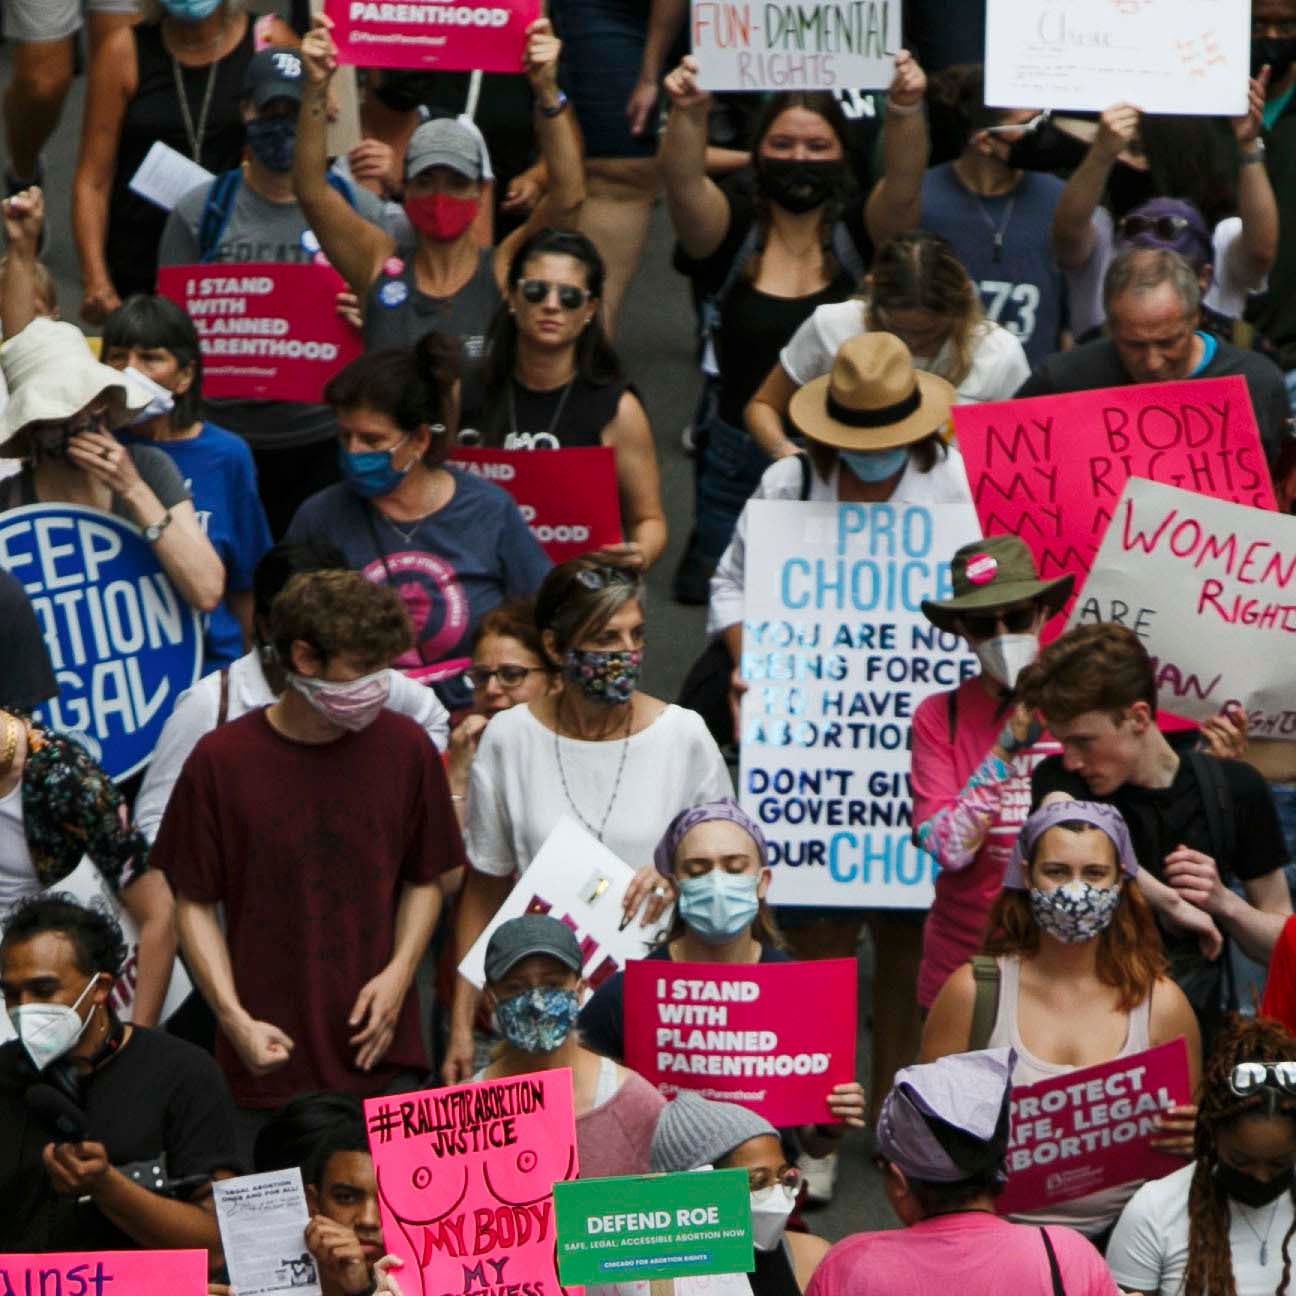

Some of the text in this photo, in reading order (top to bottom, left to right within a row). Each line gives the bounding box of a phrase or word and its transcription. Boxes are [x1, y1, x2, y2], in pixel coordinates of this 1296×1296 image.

[738, 52, 837, 88] RIGHTS
[200, 277, 274, 295] STAND
[188, 298, 246, 315] WITH
[986, 400, 1231, 468] MY BODY
[837, 504, 934, 558] PRO
[748, 768, 853, 797] DON'T
[657, 980, 760, 1002] I STAND
[657, 1004, 728, 1025] WITH
[657, 1028, 777, 1051] PLANNED
[657, 1051, 830, 1075] PARENTHOOD
[432, 1117, 518, 1158] JUSTICE
[420, 1202, 551, 1268] MY BODY
[587, 1206, 719, 1235] DEFEND ROE
